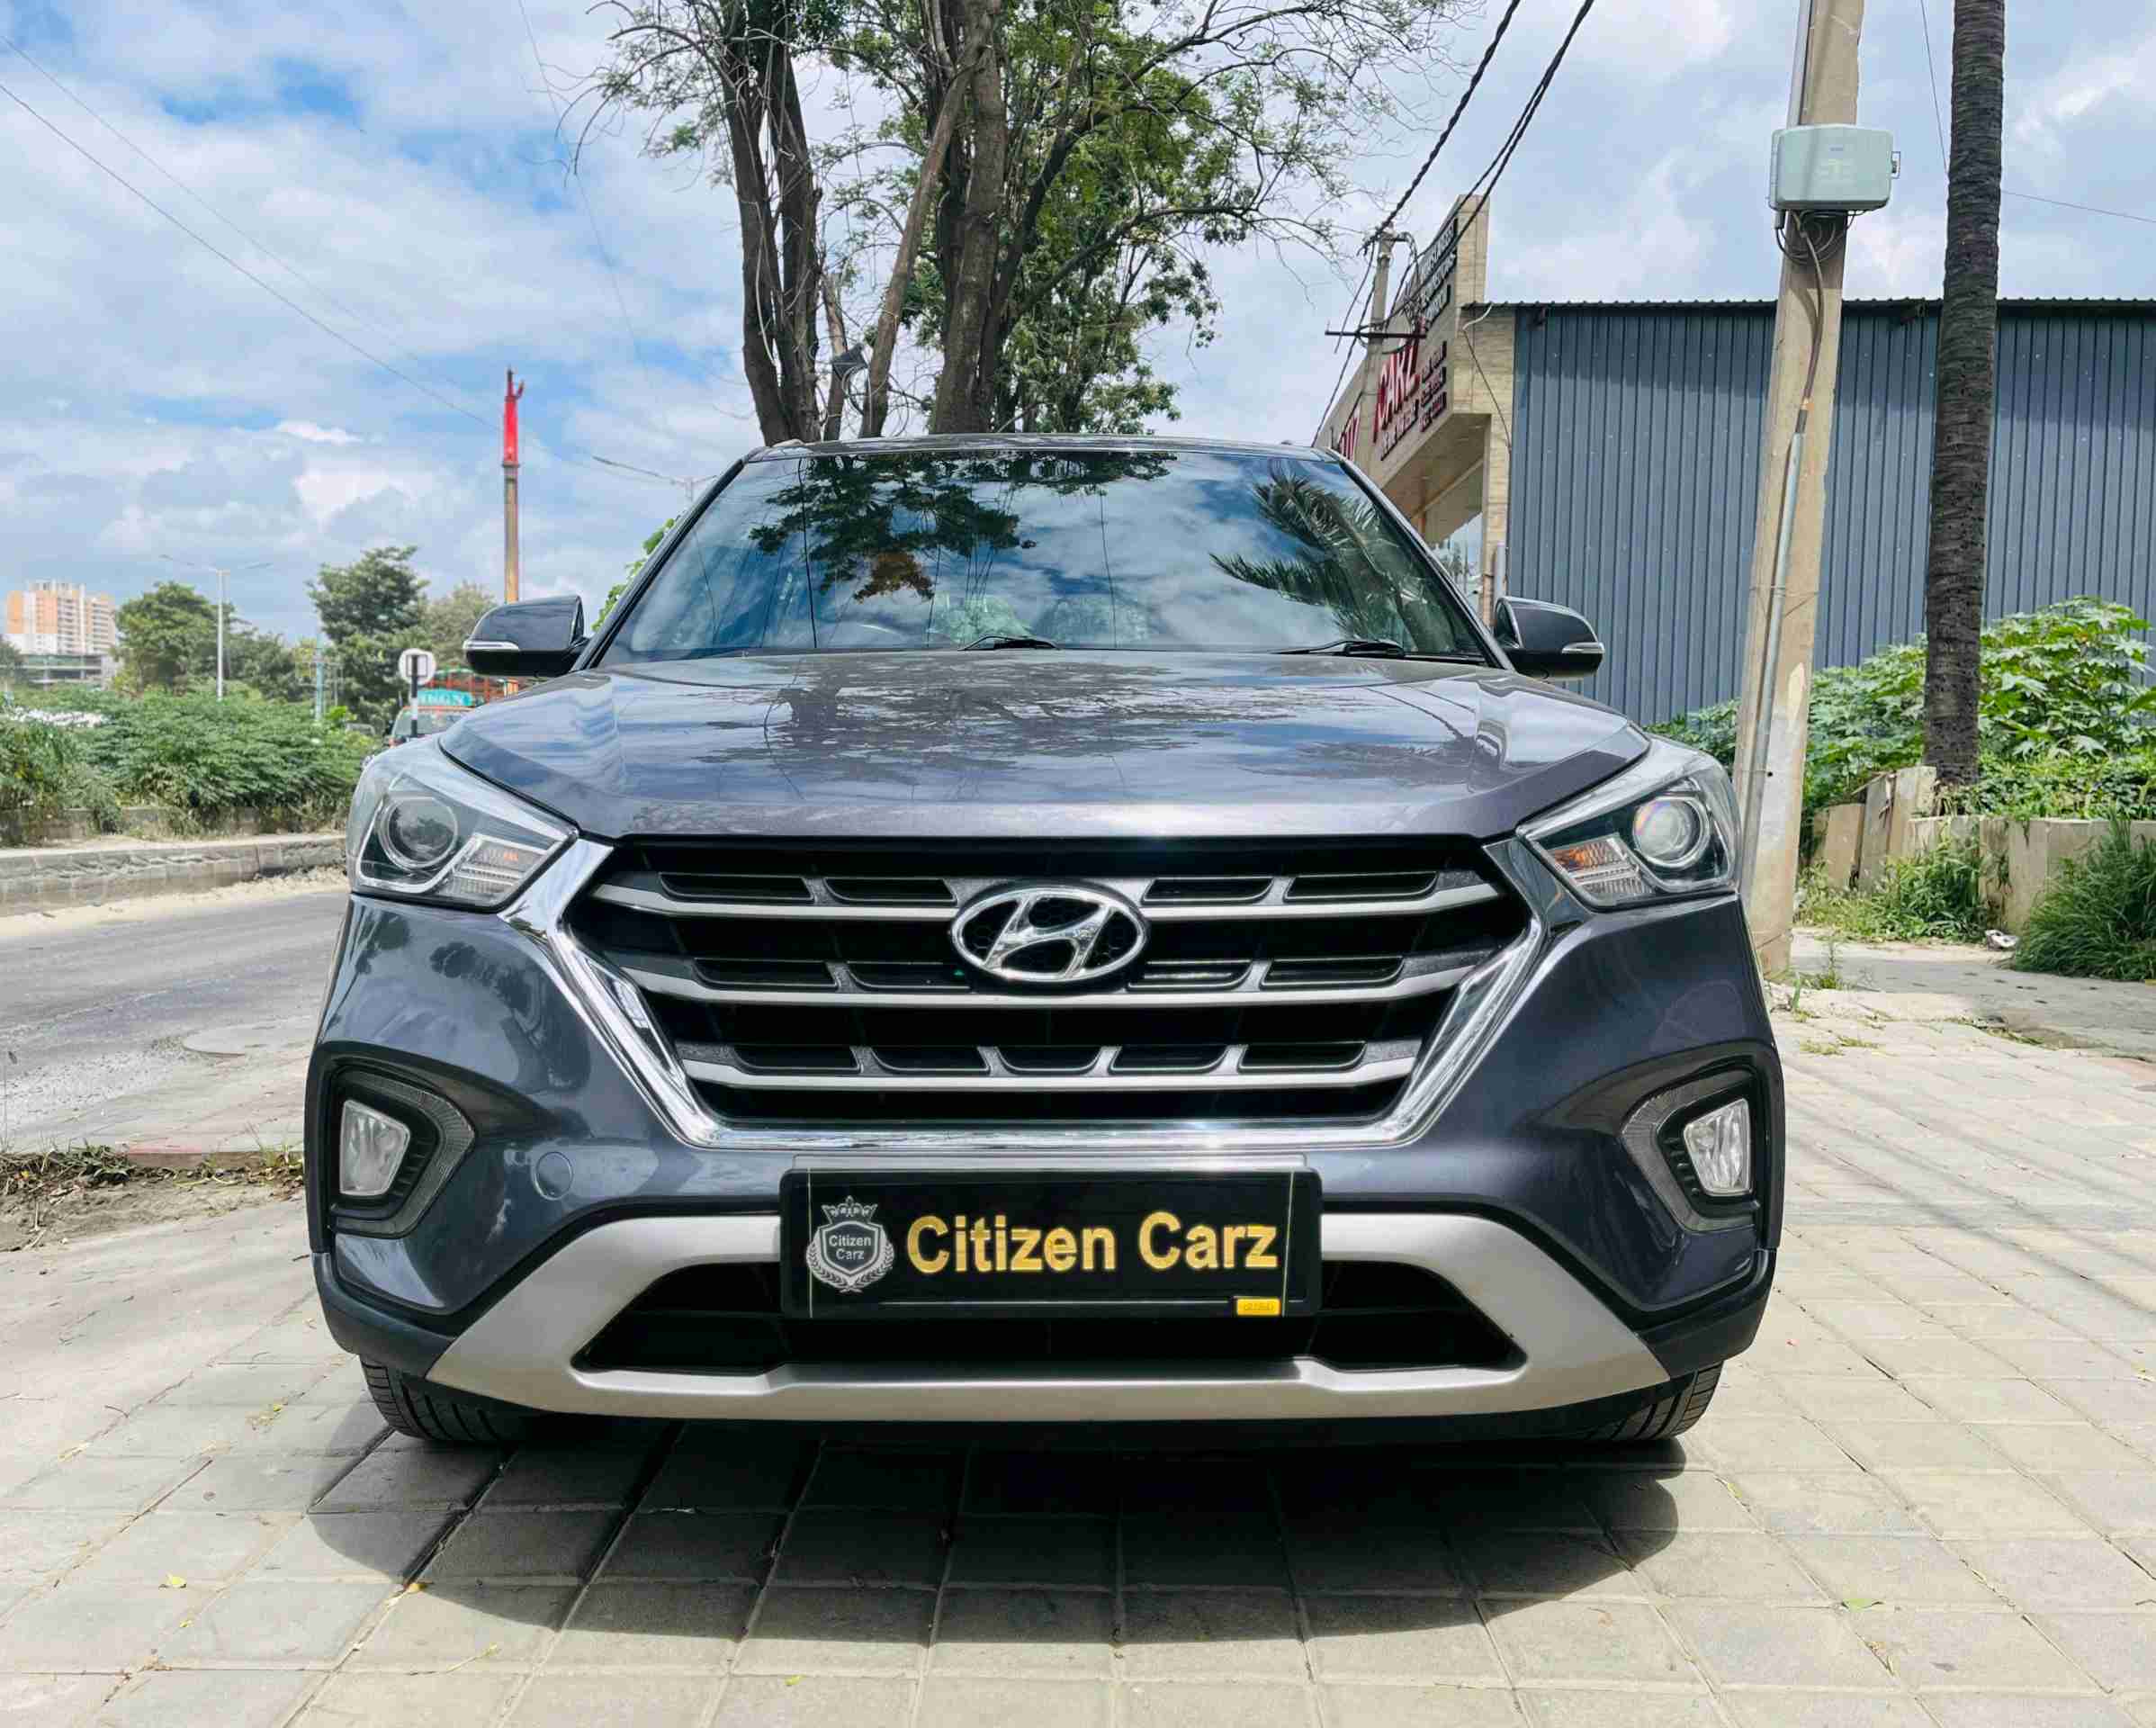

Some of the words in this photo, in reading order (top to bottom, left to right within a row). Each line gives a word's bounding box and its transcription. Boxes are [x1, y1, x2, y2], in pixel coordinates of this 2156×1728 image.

[828, 1234, 872, 1246] Citizen
[906, 1214, 1116, 1274] Citizen
[1138, 1210, 1279, 1270] Carz
[835, 1248, 865, 1260] Carz
